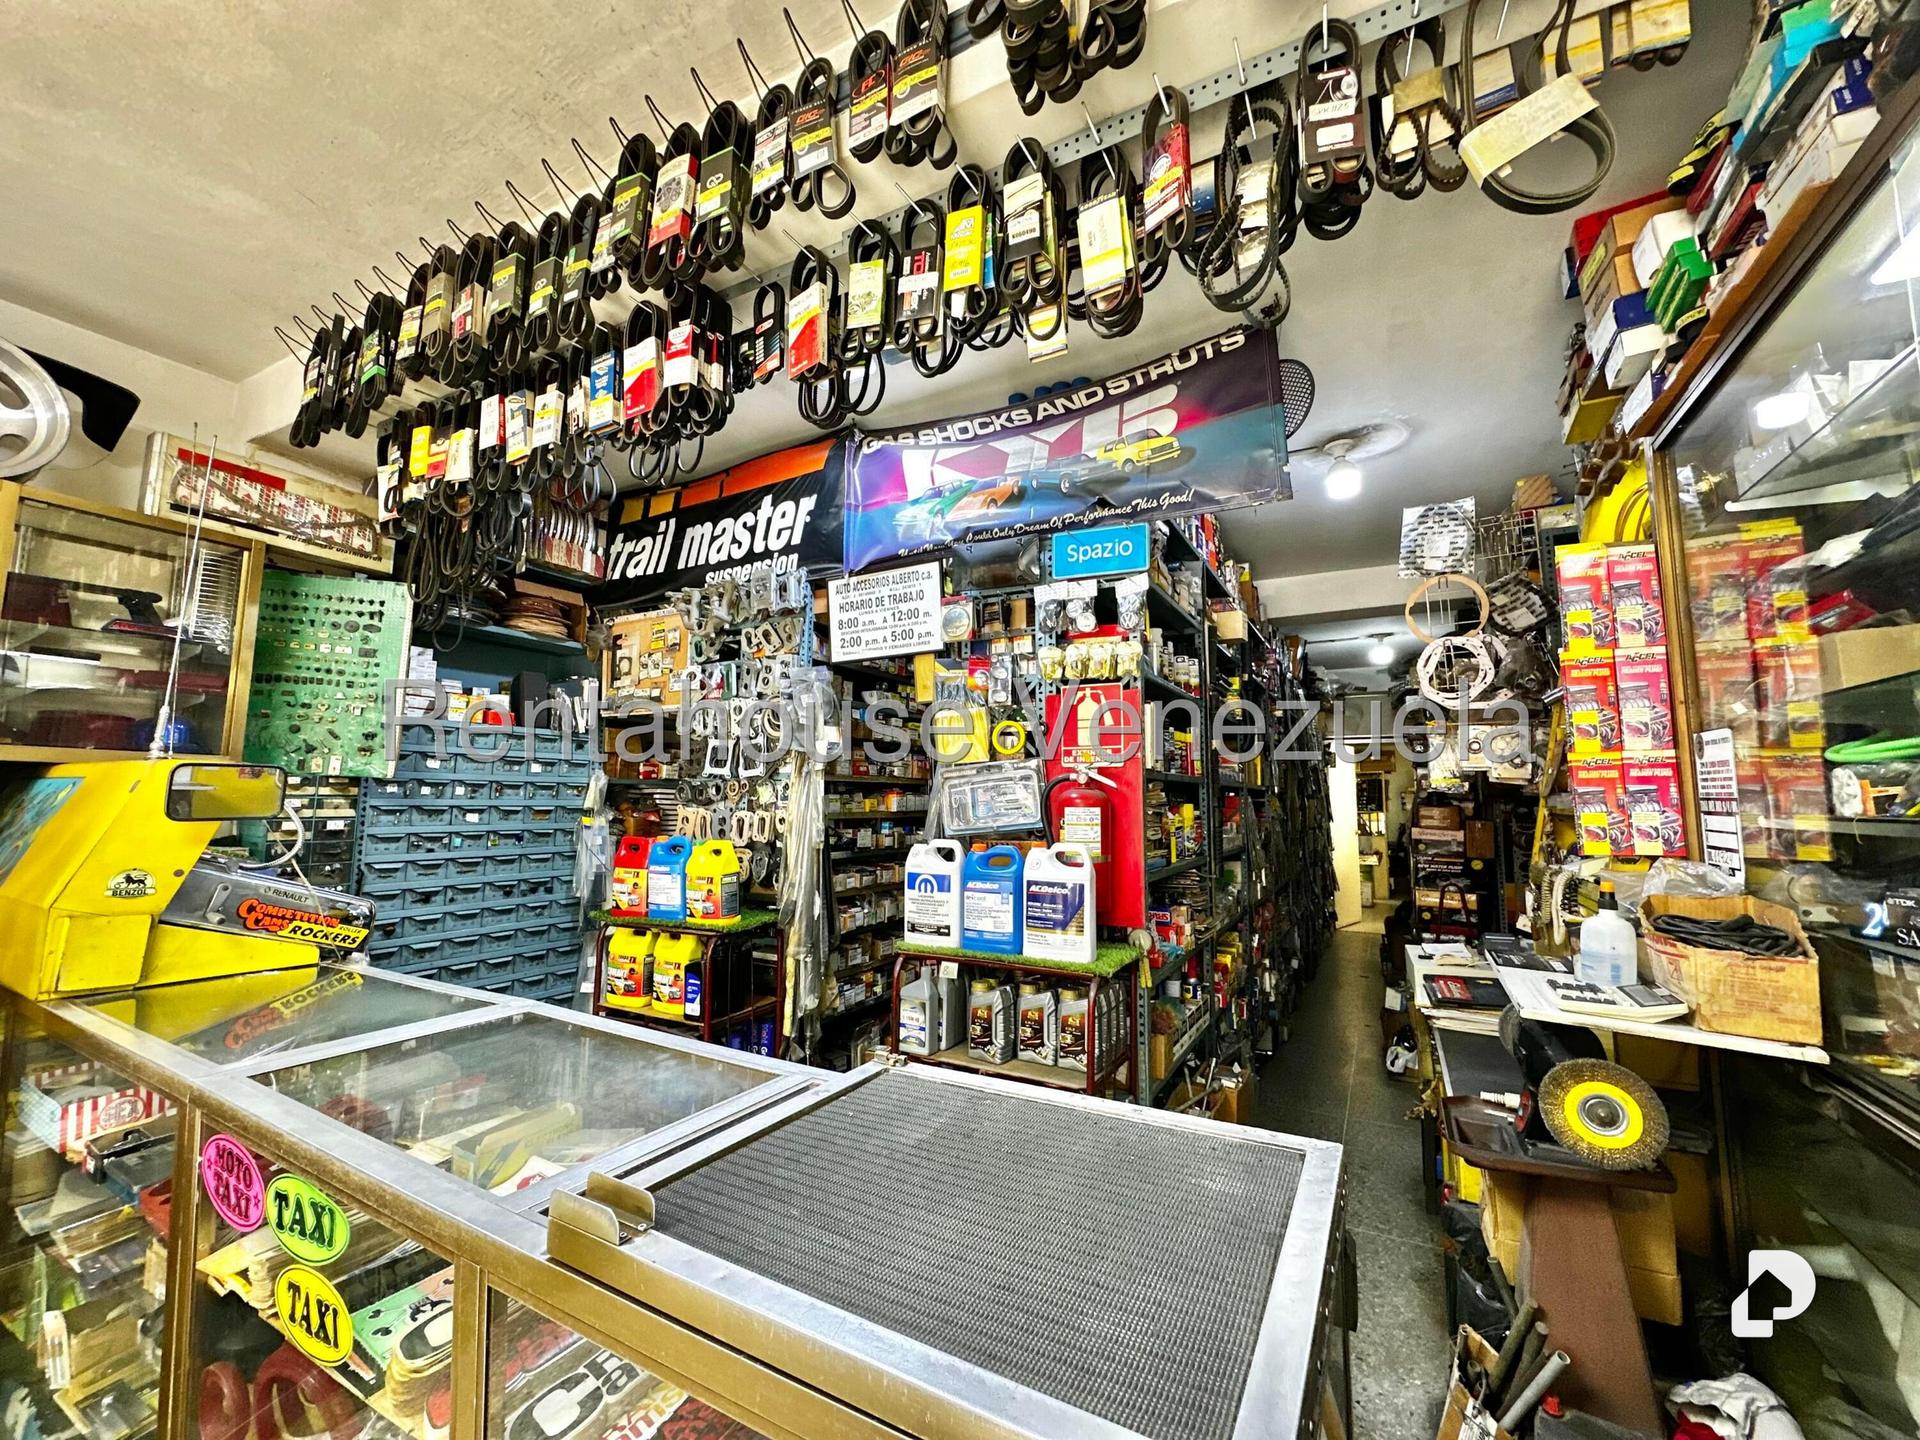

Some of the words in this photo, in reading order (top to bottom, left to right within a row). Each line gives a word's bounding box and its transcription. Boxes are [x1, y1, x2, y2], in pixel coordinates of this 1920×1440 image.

[863, 431, 915, 454] GAS
[917, 407, 1033, 446] SHOCKS
[1036, 386, 1105, 421] AND
[1105, 329, 1246, 396] STRUTS
[965, 530, 992, 545] Could
[992, 524, 1016, 540] Only
[1014, 521, 1050, 535] Dream
[1050, 514, 1065, 528] Of
[1063, 505, 1133, 529] Performance
[1132, 497, 1158, 512] This
[1159, 488, 1195, 507] Good!
[606, 517, 676, 581] trail
[676, 492, 818, 570] master
[1067, 540, 1133, 564] Spazio
[704, 552, 799, 588] suspension
[835, 582, 851, 596] AUTO
[852, 575, 890, 592] ACCESORIOS
[892, 570, 919, 586] ALBERTO
[921, 571, 933, 580] c.a.
[839, 598, 873, 614] HORARIO
[875, 596, 885, 607] DE
[888, 589, 925, 606] TRABAJO
[838, 617, 859, 630] 8:00
[882, 616, 888, 624] A
[891, 607, 919, 622] 12:00
[840, 635, 862, 649] 2:00
[865, 639, 881, 648] p.m.
[882, 636, 888, 644] A
[891, 628, 914, 642] 5:00
[917, 630, 935, 640] p.m.
[111, 889, 148, 897] BENZOL
[272, 889, 309, 903] RENAULT
[1029, 884, 1070, 895] ACDelco
[237, 898, 341, 928] COMPETITION
[245, 913, 290, 932] CAMS
[288, 925, 360, 945] ROCKERS
[214, 1142, 253, 1192] MOTO
[213, 1169, 251, 1223] TAXI
[274, 1186, 337, 1250] TAXI
[286, 1279, 340, 1352] TAXI
